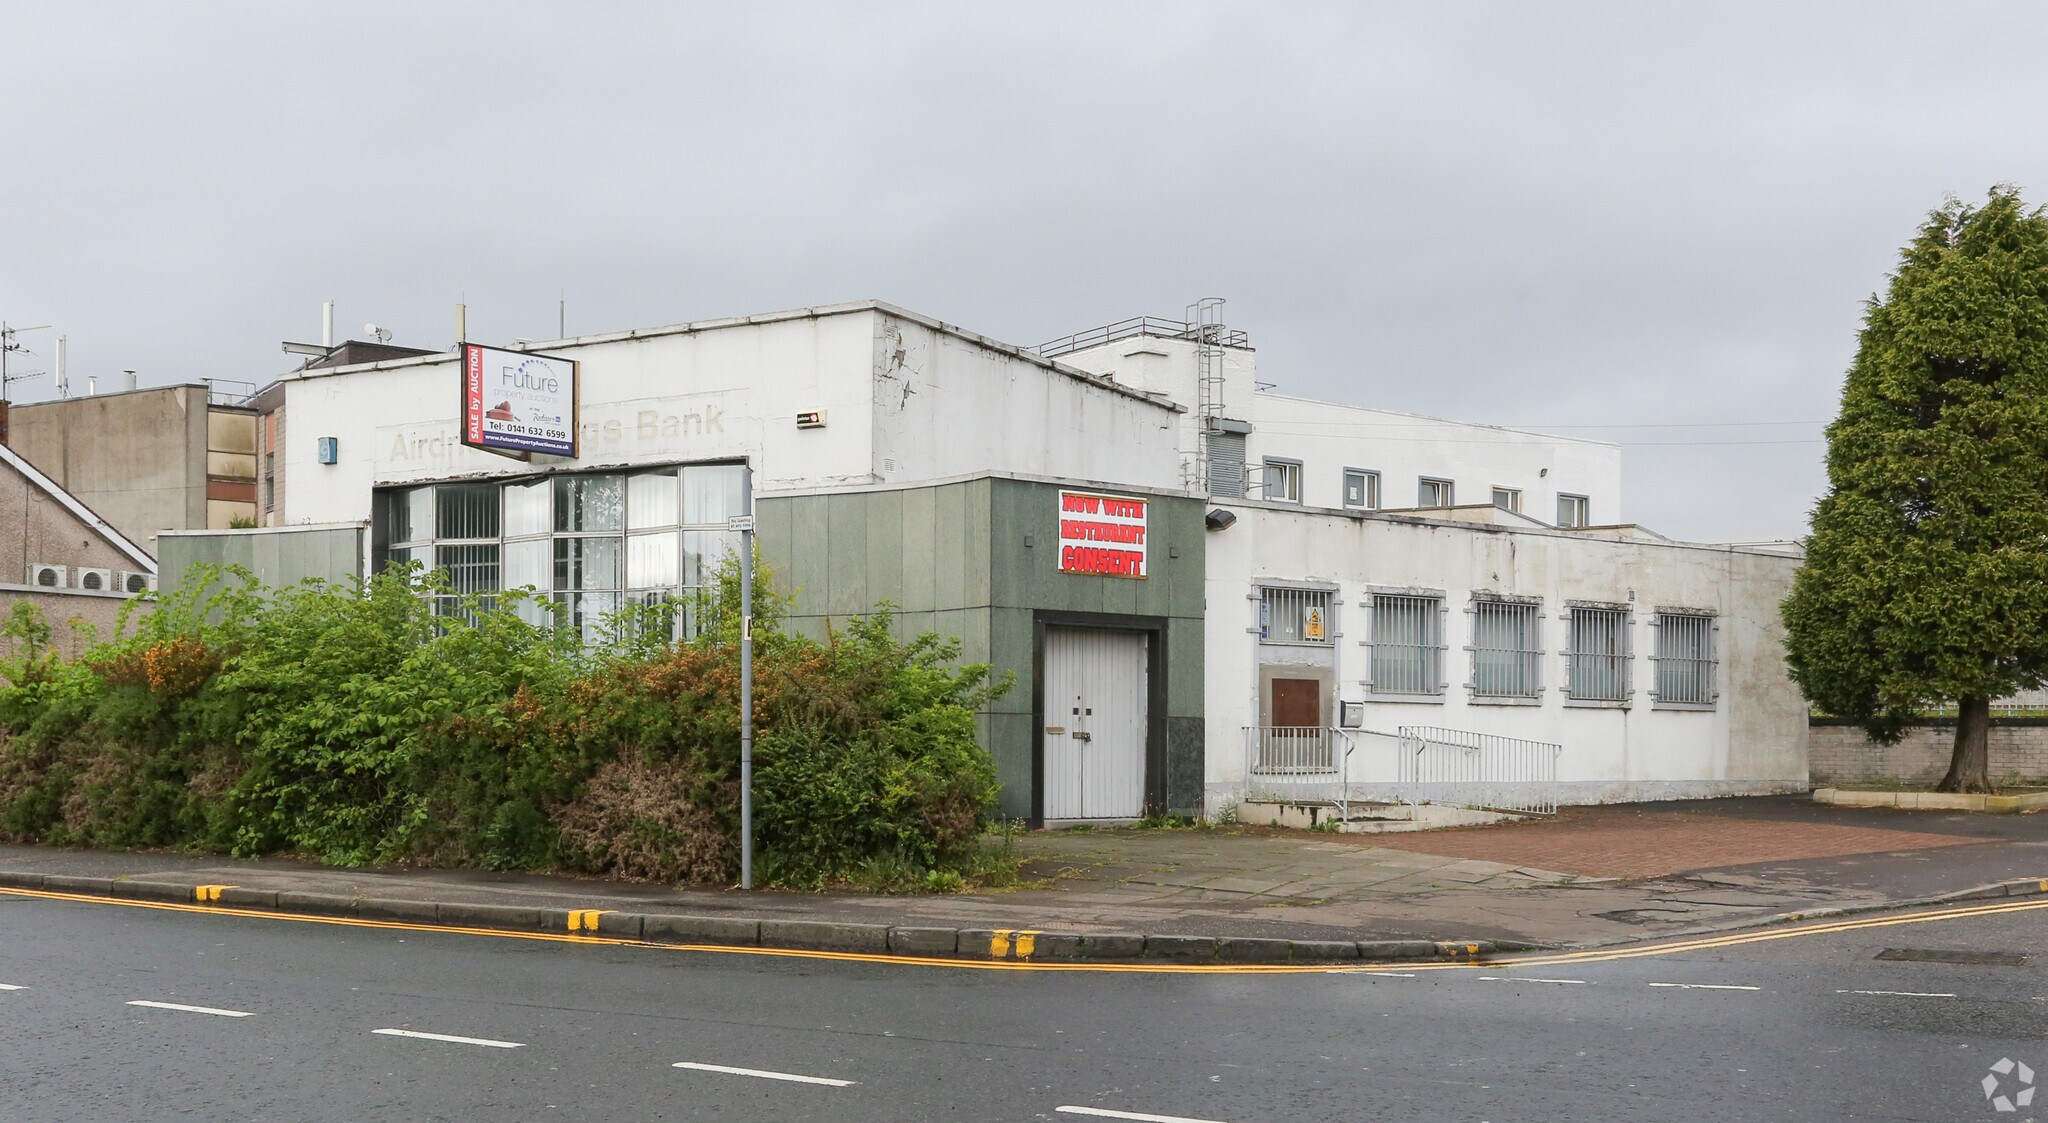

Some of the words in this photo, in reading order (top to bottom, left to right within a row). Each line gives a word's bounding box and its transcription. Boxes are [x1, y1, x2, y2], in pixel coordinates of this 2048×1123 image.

[470, 348, 479, 394] AUCTION
[502, 366, 558, 393] Future
[470, 397, 480, 411] by
[494, 389, 525, 400] property
[527, 393, 558, 404] auctions
[471, 414, 479, 440] SALE
[489, 421, 504, 431] Tel:
[507, 423, 525, 434] 0141
[528, 427, 543, 436] 632
[546, 429, 566, 439] 6599
[636, 404, 725, 441] Bank
[484, 434, 569, 450] www.FuturePropertyAuctions.co.uk
[1063, 496, 1100, 514] NOW
[1103, 500, 1144, 518] WITH
[1061, 520, 1145, 544] RESTAURANT
[1062, 546, 1144, 574] CONSENT
